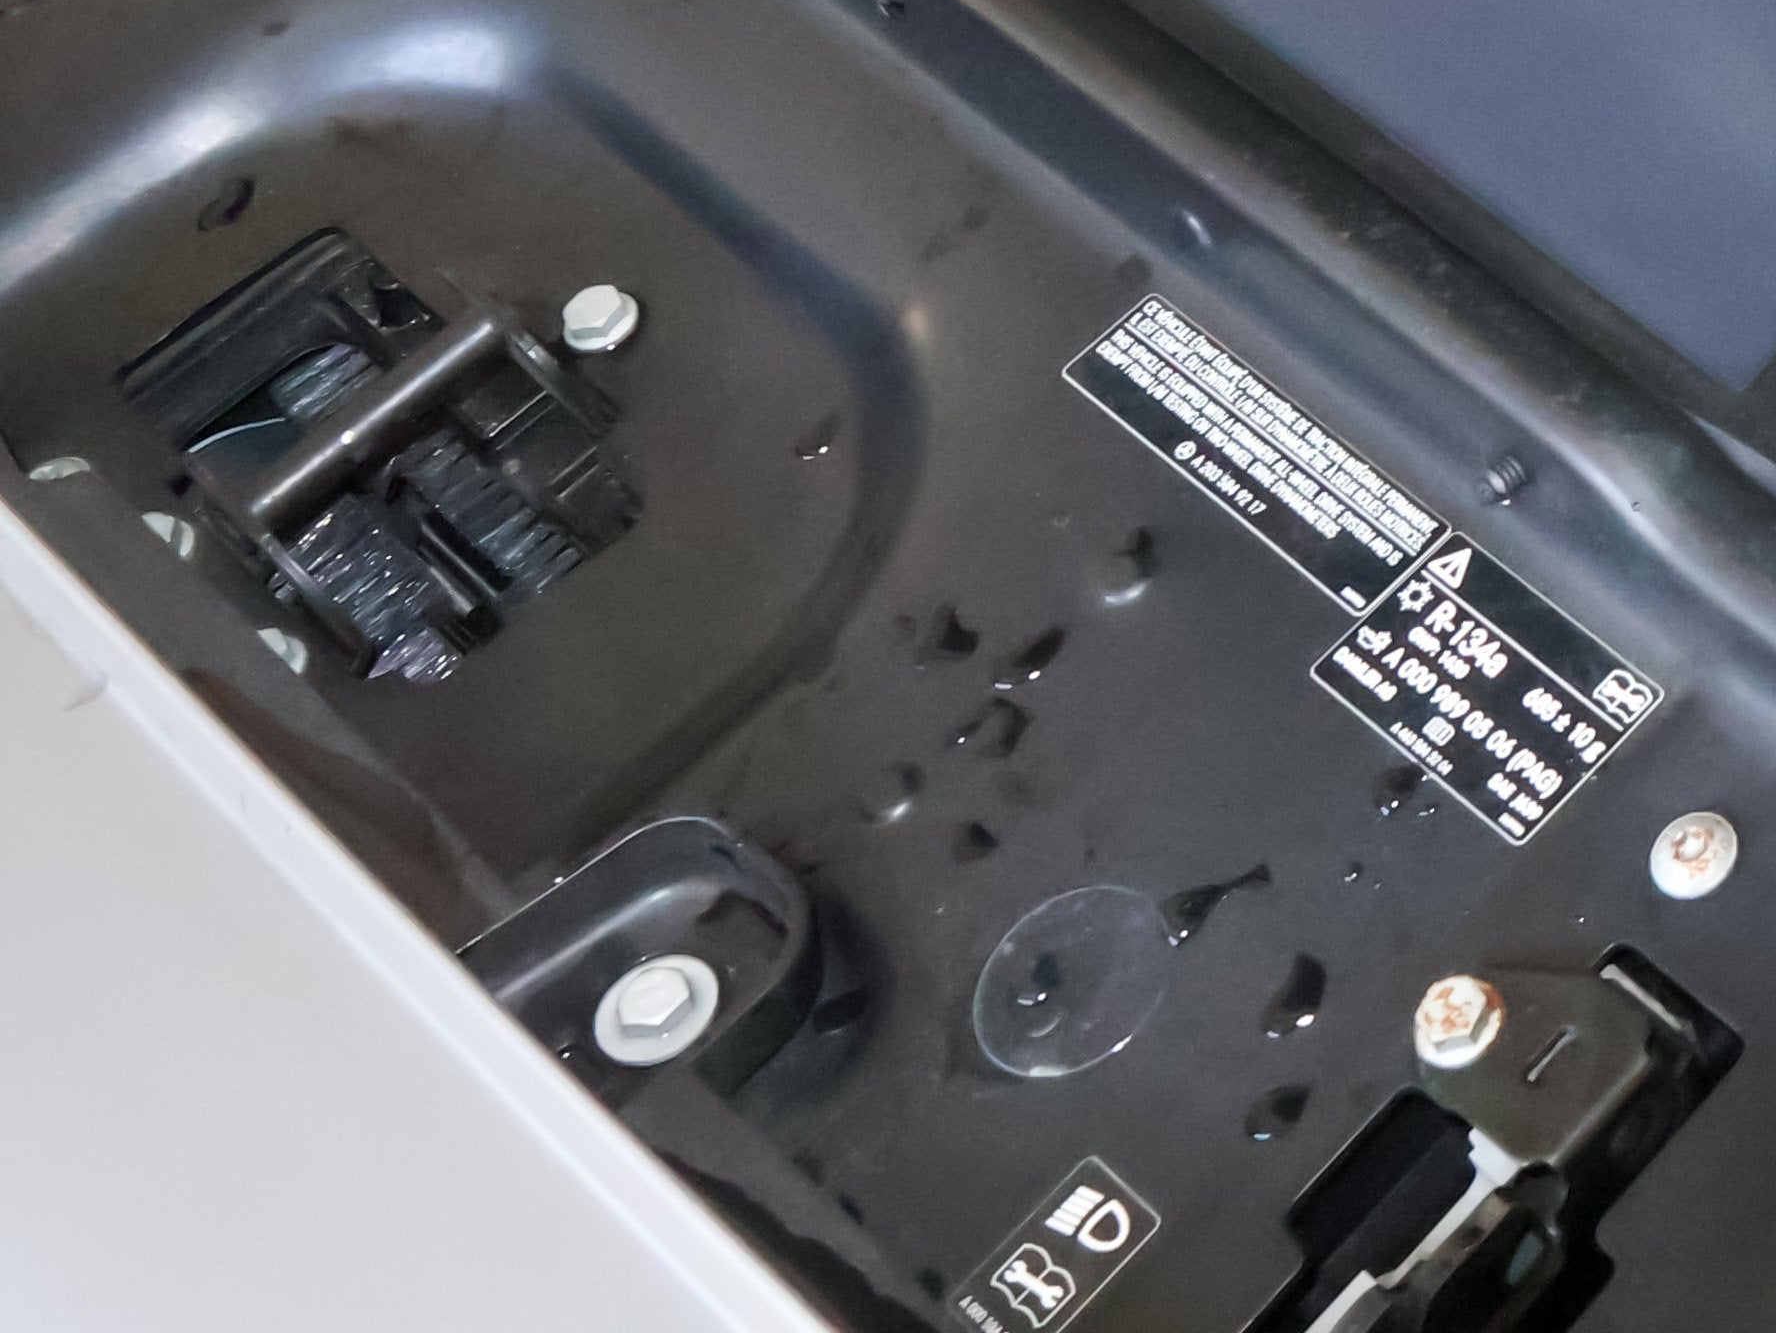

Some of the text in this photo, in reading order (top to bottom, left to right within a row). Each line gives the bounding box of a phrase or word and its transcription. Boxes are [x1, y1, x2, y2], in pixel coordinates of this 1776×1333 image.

[1109, 328, 1135, 351] THIS
[1126, 341, 1166, 375] VEHICLE
[1156, 366, 1174, 381] IS
[1142, 300, 1163, 317] CE
[1291, 416, 1313, 436] DE
[1304, 426, 1350, 466] TRACTION
[1164, 372, 1210, 410] EQUIPPED
[1095, 340, 1134, 371] EXEMPT
[1123, 362, 1156, 389] FROM
[1161, 391, 1200, 425] TESTING
[1191, 416, 1213, 435] ON
[1246, 460, 1279, 489] DRIVE
[1134, 317, 1159, 338] EST
[1181, 353, 1205, 373] DU
[1248, 406, 1276, 429] SUR
[1329, 470, 1361, 497] DEUX
[1201, 400, 1230, 426] WITH
[1219, 417, 1236, 431] A
[1226, 421, 1282, 466] PERMANENT
[1189, 454, 1206, 469] A
[1233, 488, 1254, 508] 92
[1246, 499, 1267, 515] 17
[1312, 491, 1347, 520] DRIVE
[1336, 510, 1377, 545] SYSTEM
[1367, 536, 1394, 558] AND
[1385, 549, 1404, 567] IS
[1423, 599, 1509, 679] R-134a
[1521, 687, 1563, 722] 685
[1567, 721, 1597, 749] 10
[1380, 647, 1563, 800] A 000 989 05 06 (PAG)
[1486, 772, 1518, 801] SAE
